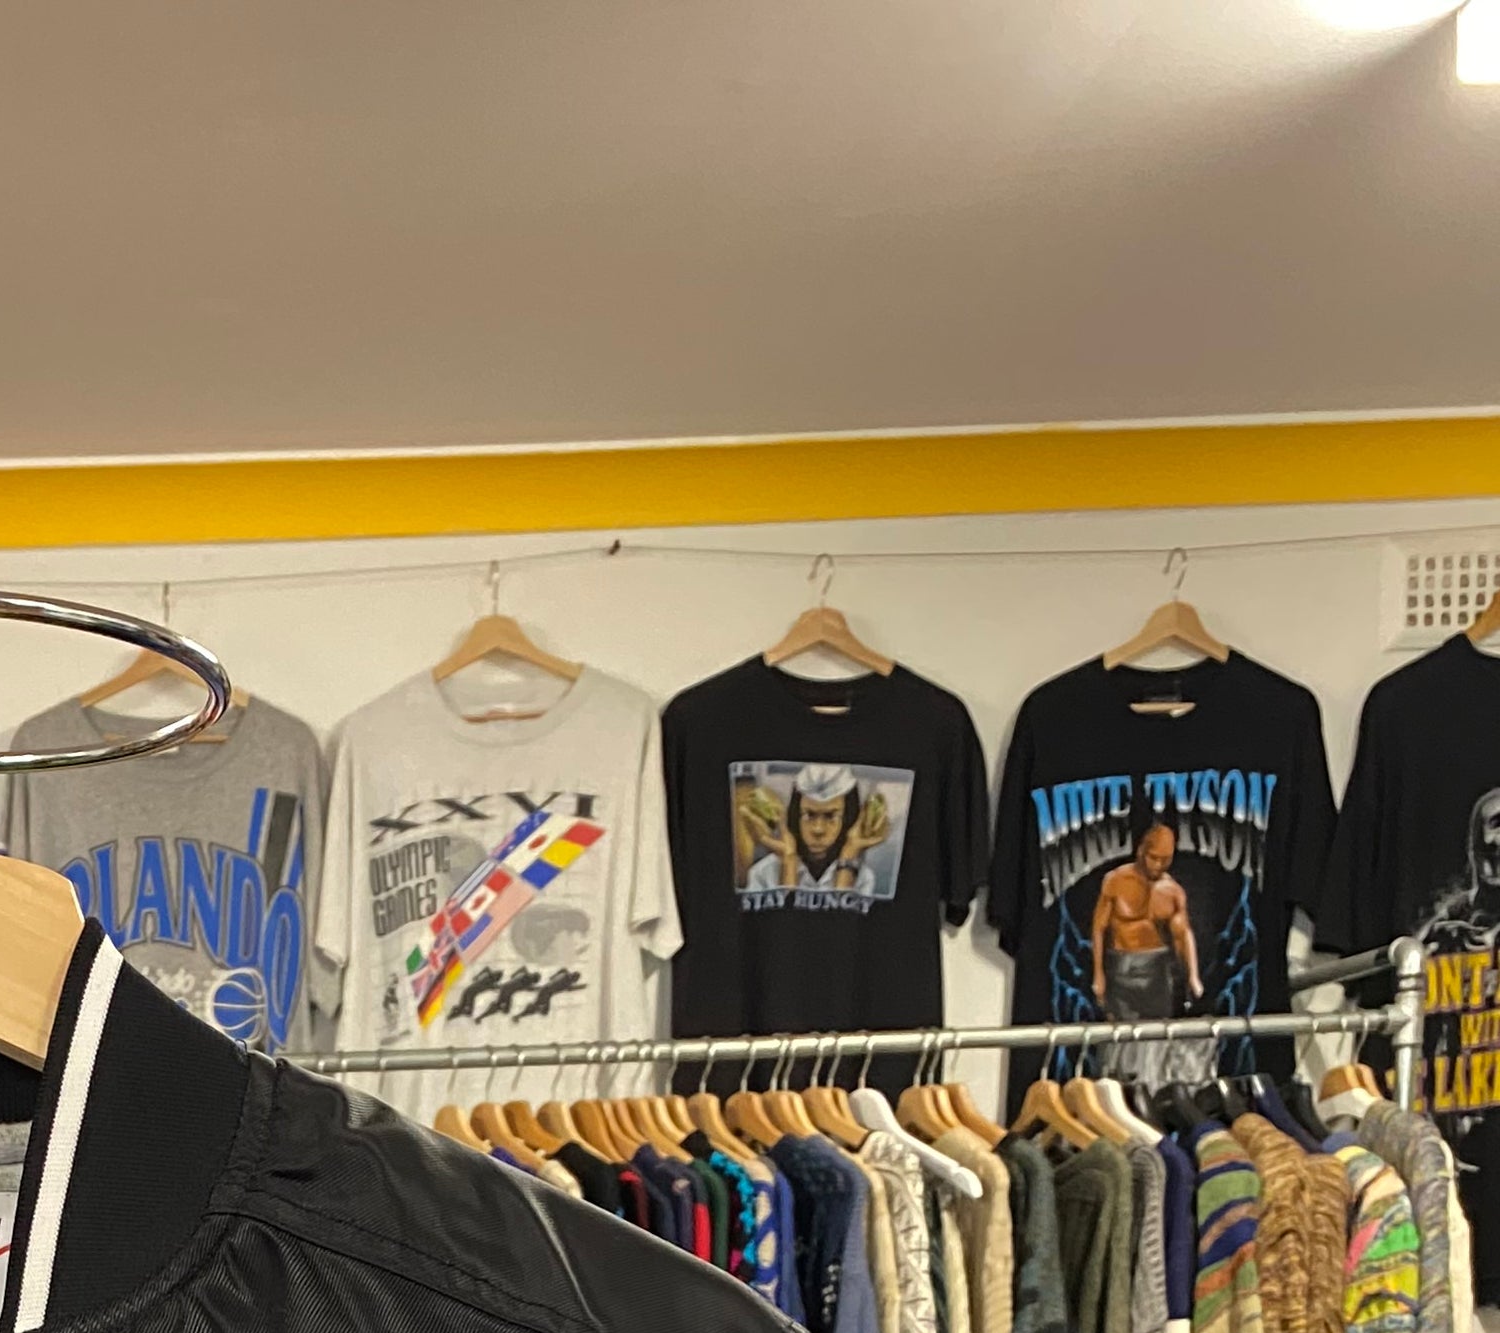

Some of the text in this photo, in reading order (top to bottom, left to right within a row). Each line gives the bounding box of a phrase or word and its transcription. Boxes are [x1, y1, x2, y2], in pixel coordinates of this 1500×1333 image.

[368, 836, 451, 897] OLYMPIC
[1031, 768, 1278, 909] MIKE TYSON
[372, 878, 438, 937] GAMES
